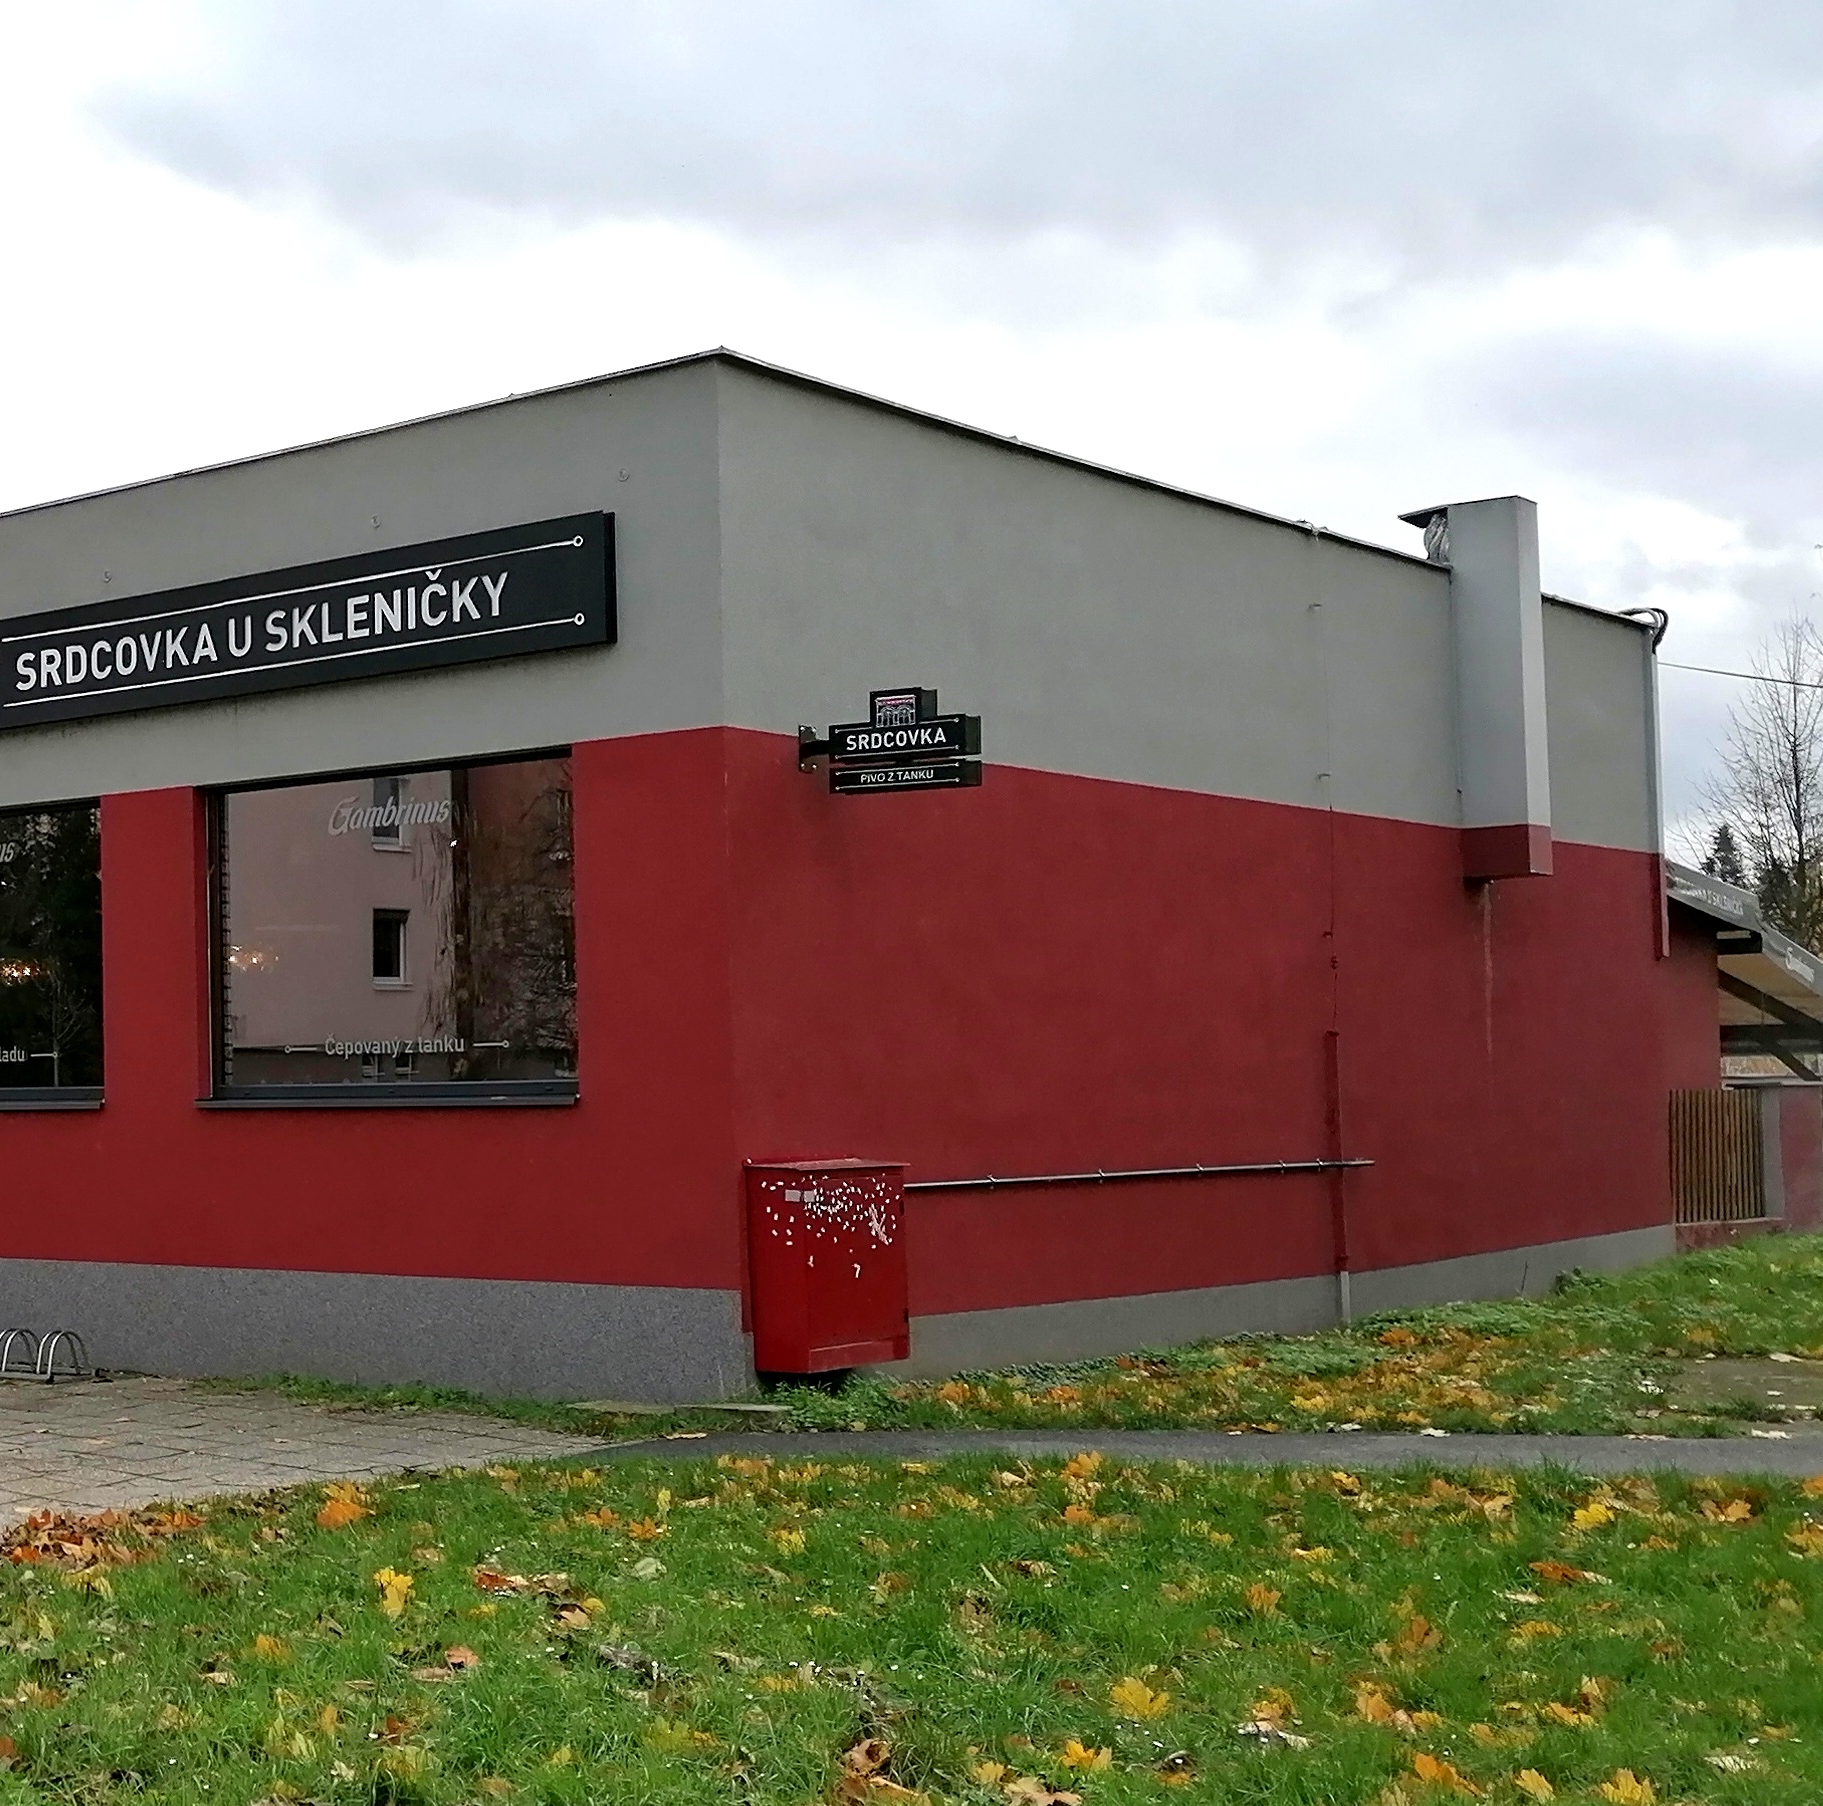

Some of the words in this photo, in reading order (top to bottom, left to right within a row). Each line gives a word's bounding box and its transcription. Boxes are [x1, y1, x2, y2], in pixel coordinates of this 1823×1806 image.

[15, 622, 219, 692] SRDCOVKA
[227, 615, 253, 658] U
[264, 568, 509, 652] SKLENIČKY
[846, 727, 947, 751] SRDCOVKA
[860, 772, 886, 784] PIVO
[887, 771, 895, 782] Z
[896, 769, 934, 781] TANKU
[327, 795, 451, 837] Gambrinus
[325, 1032, 402, 1060] Čepovaný
[404, 1039, 414, 1054] z
